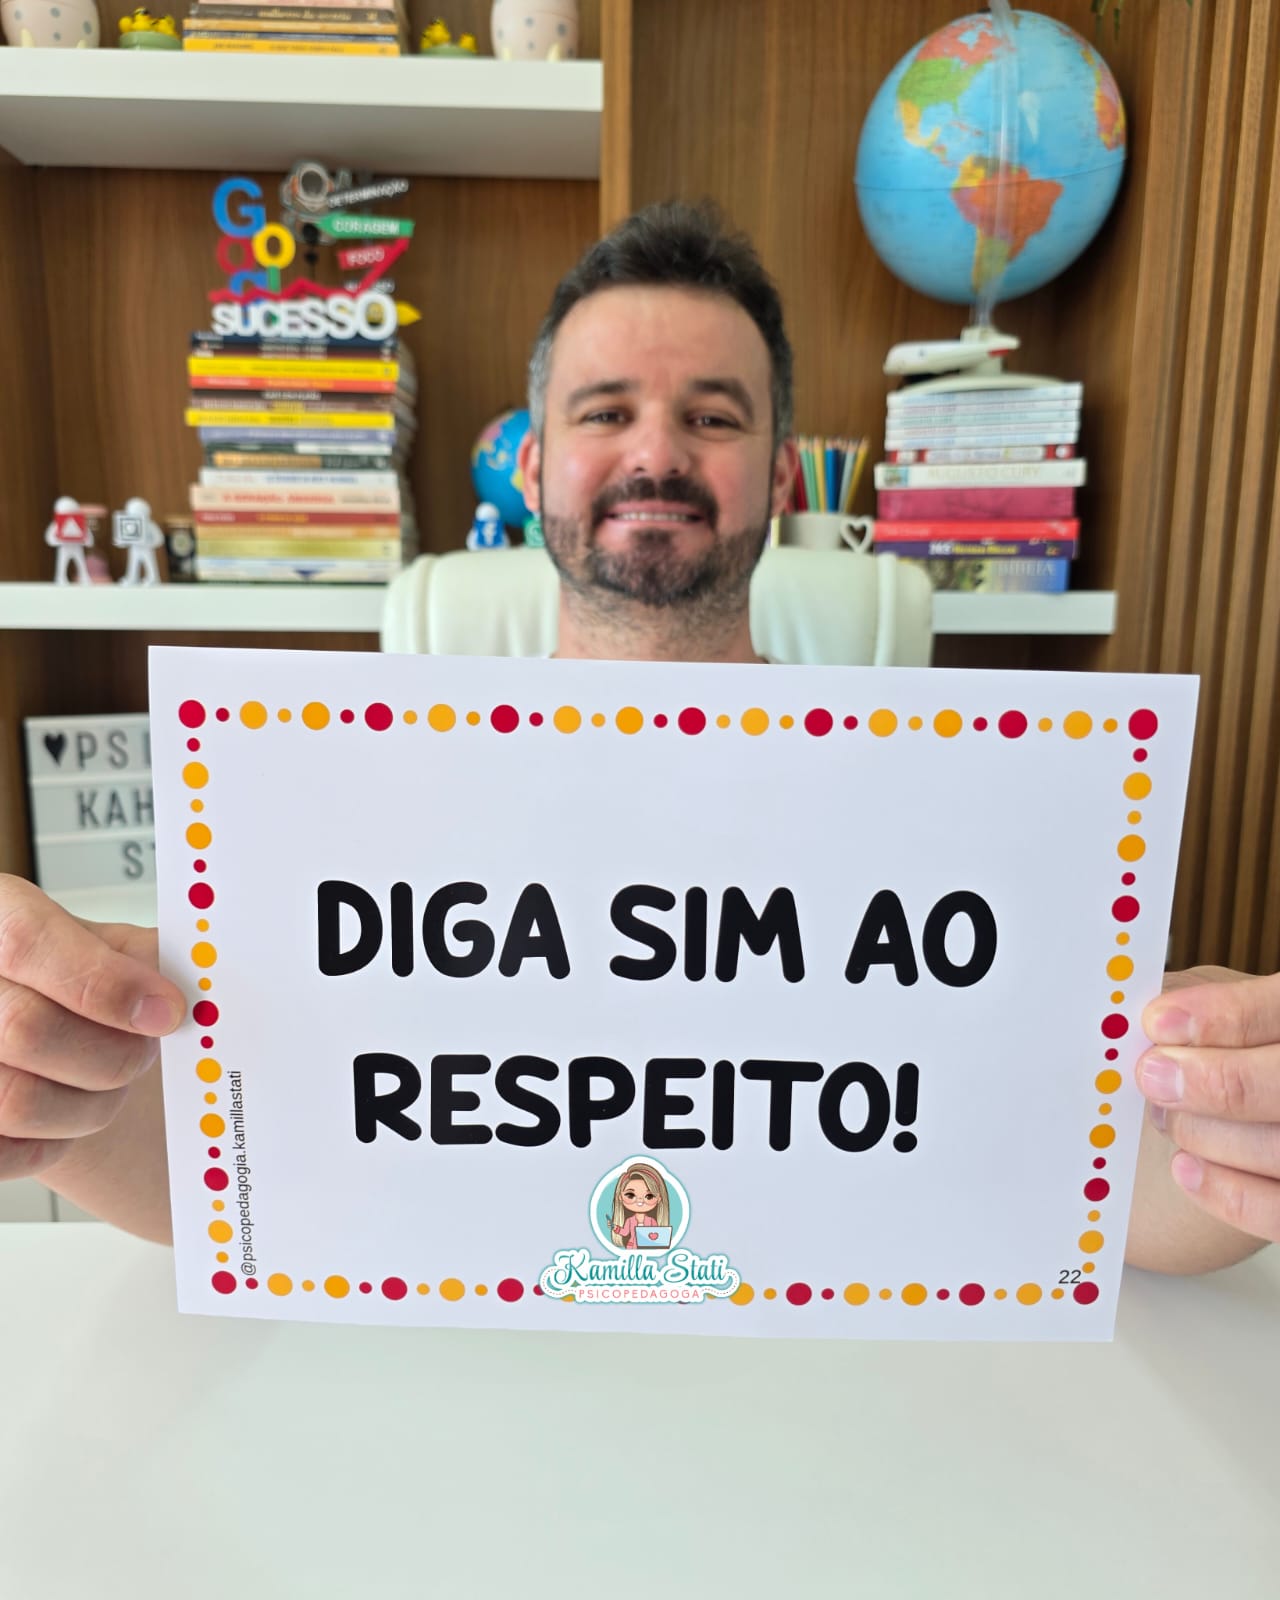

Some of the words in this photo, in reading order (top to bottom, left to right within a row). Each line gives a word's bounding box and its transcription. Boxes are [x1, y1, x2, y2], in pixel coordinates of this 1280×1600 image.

[212, 292, 397, 341] SUCESSO
[121, 841, 156, 879] S
[317, 880, 571, 980] DIGA
[609, 884, 805, 984] SIM
[845, 889, 998, 988] AO
[353, 1052, 920, 1153] RESPEITO!
[227, 1070, 257, 1276] @psicopedagogia.kamillastati
[1058, 1269, 1082, 1284] 22
